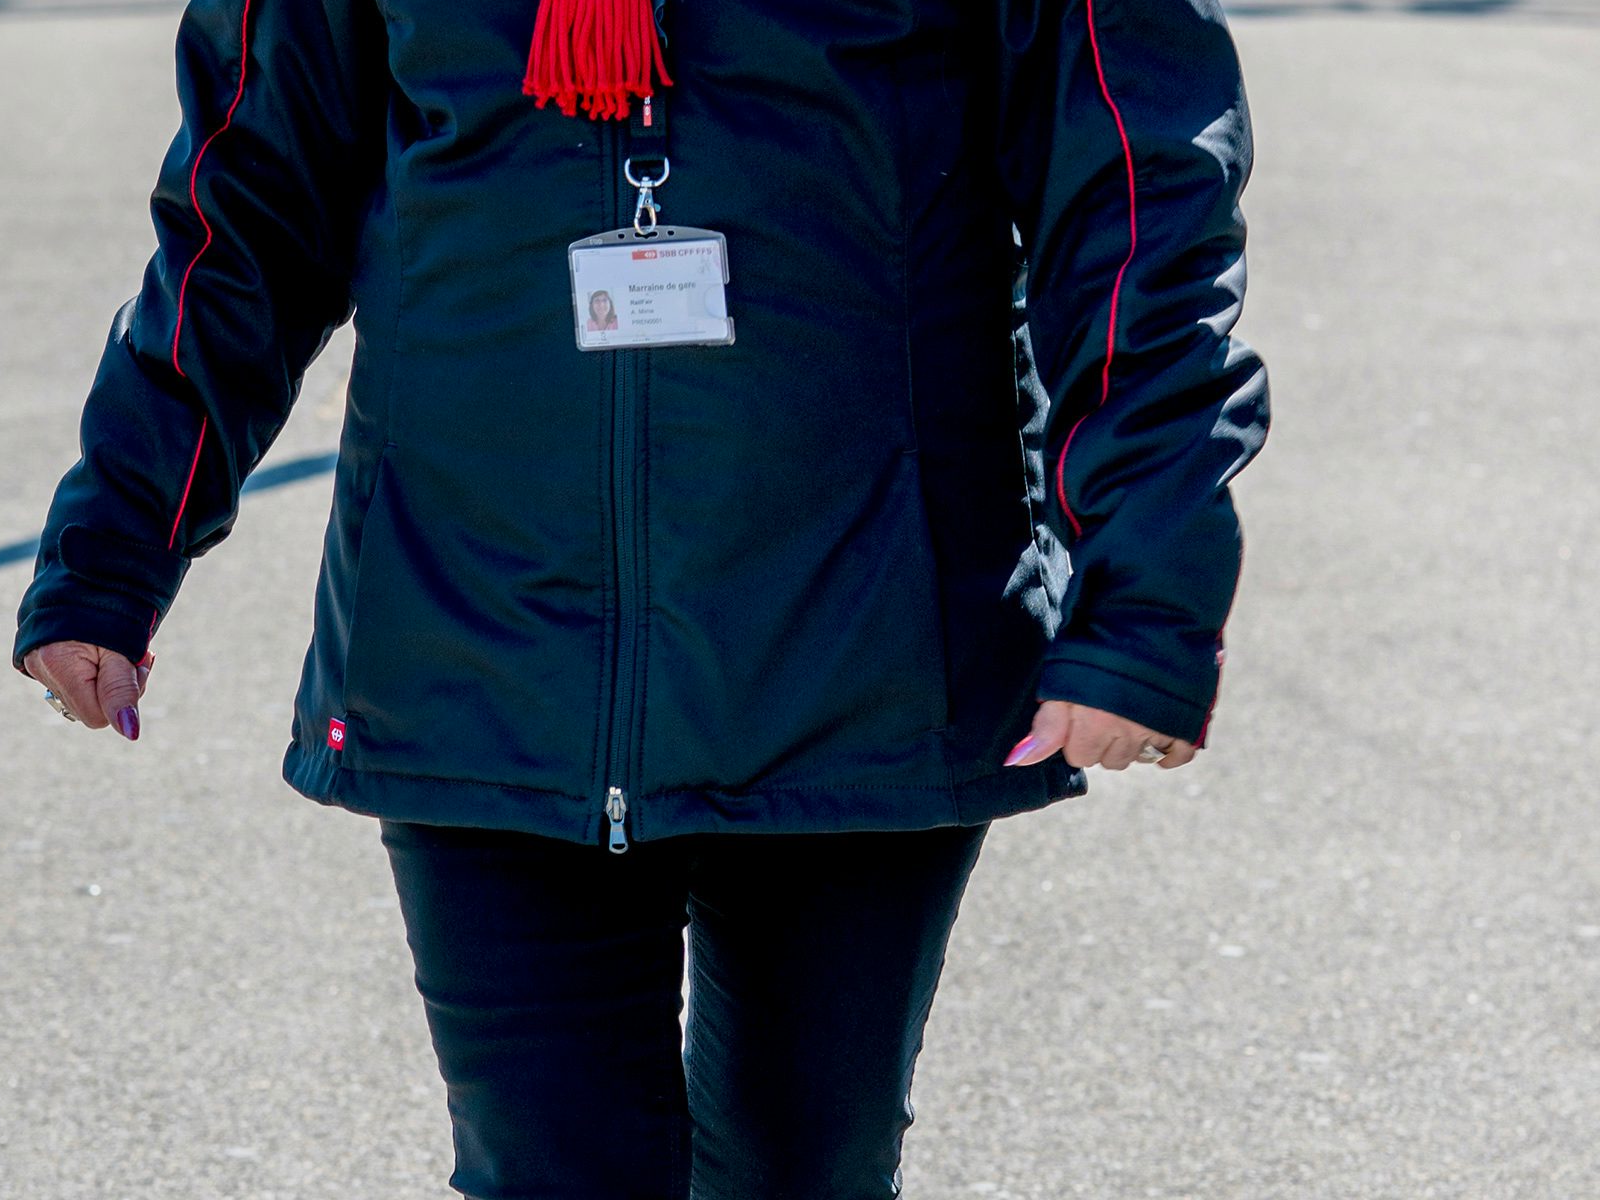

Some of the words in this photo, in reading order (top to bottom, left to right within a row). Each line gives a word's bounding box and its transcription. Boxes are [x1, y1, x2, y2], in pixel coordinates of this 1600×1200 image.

[660, 249, 677, 258] SBB
[678, 248, 694, 257] CFF
[696, 247, 712, 256] FFS
[629, 284, 664, 293] Marraine
[678, 282, 696, 291] gare
